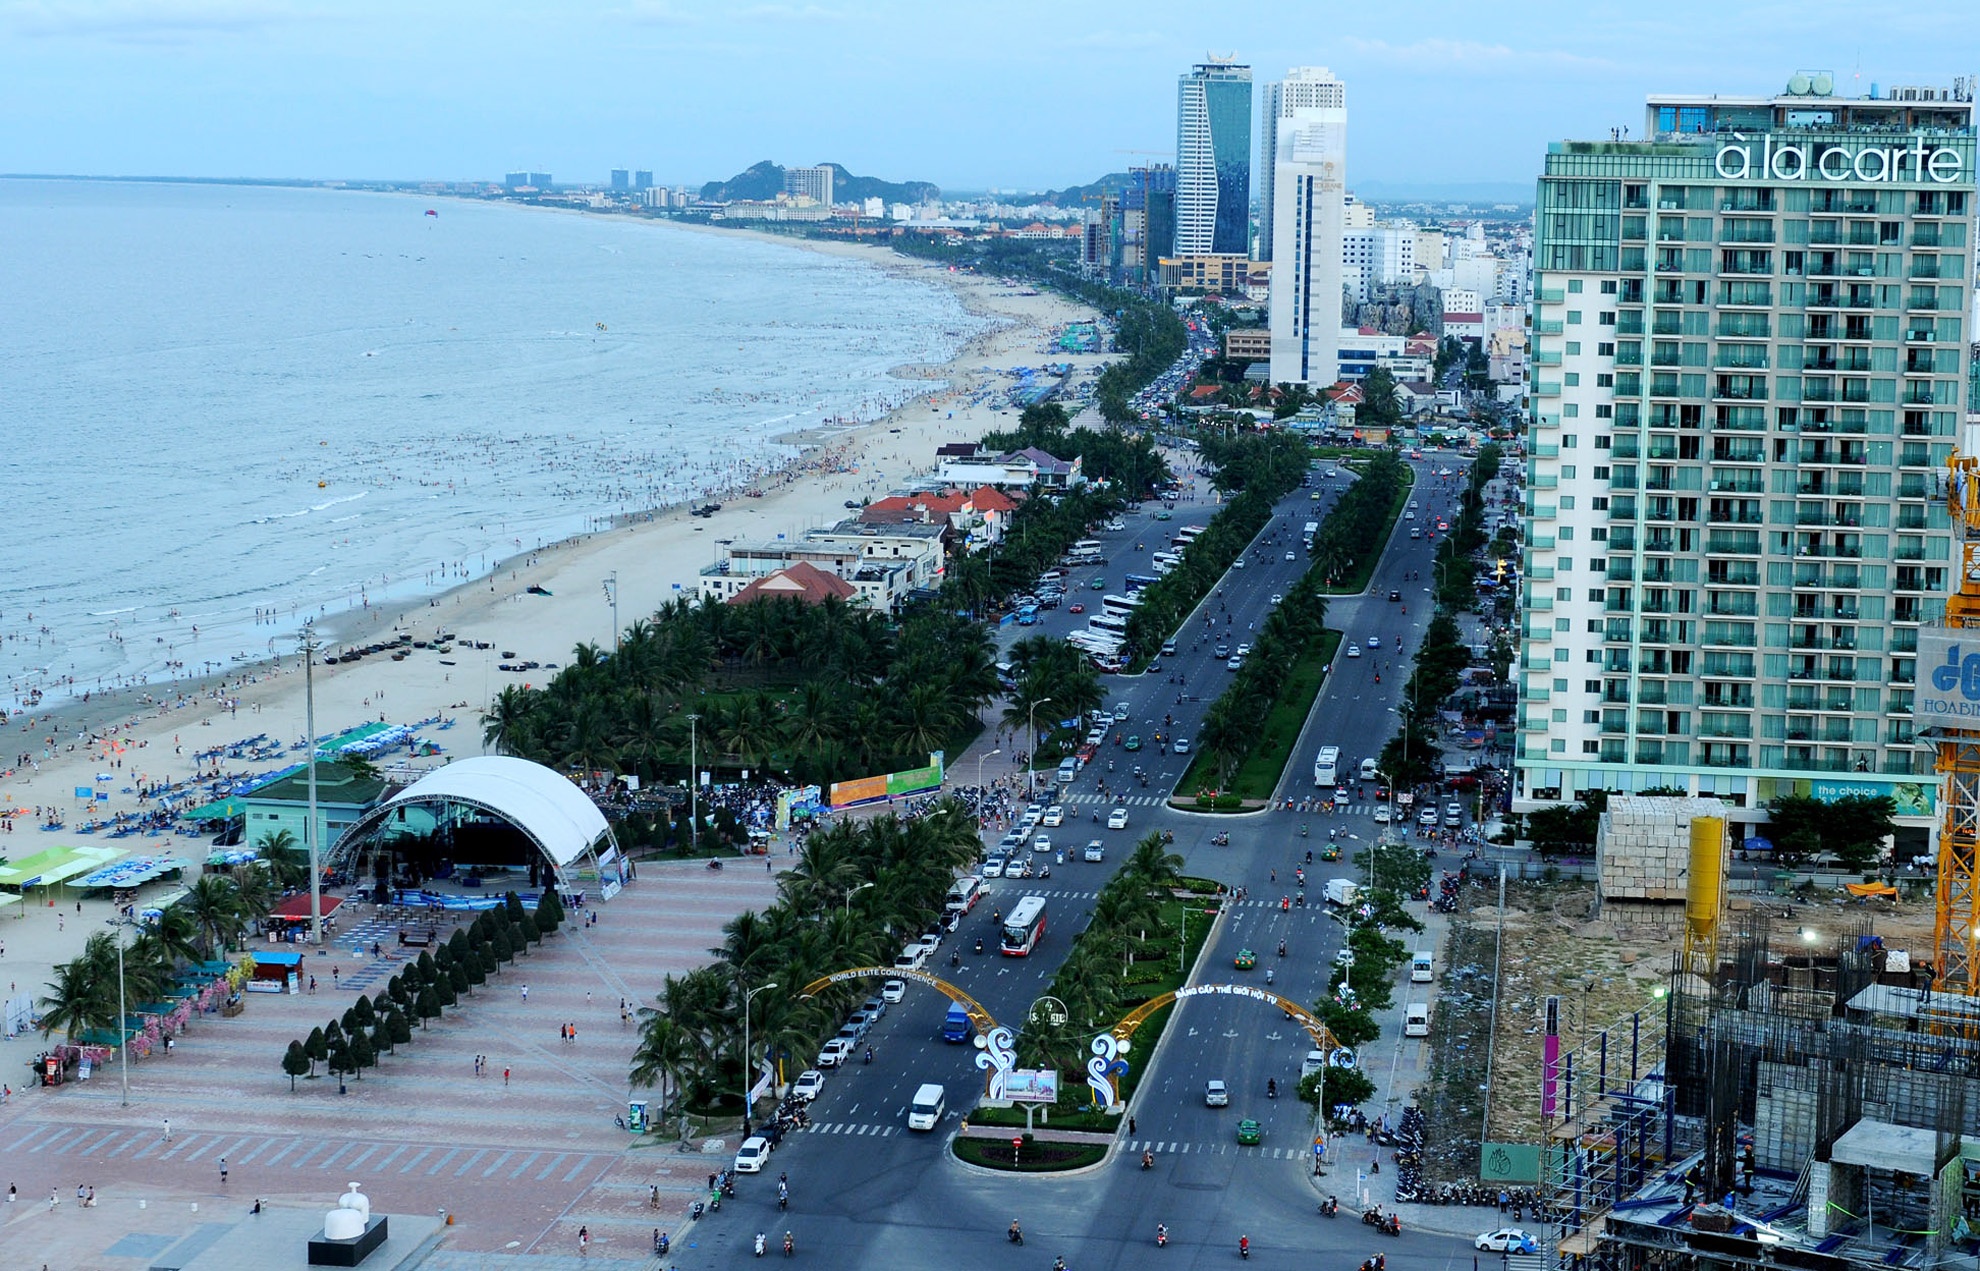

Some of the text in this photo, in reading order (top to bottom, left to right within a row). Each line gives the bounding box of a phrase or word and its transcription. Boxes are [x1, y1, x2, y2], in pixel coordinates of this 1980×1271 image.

[1715, 131, 1963, 182] à la carte
[1818, 785, 1877, 796] the choice
[829, 969, 937, 987] WORLD ELITE CONVERGENCE
